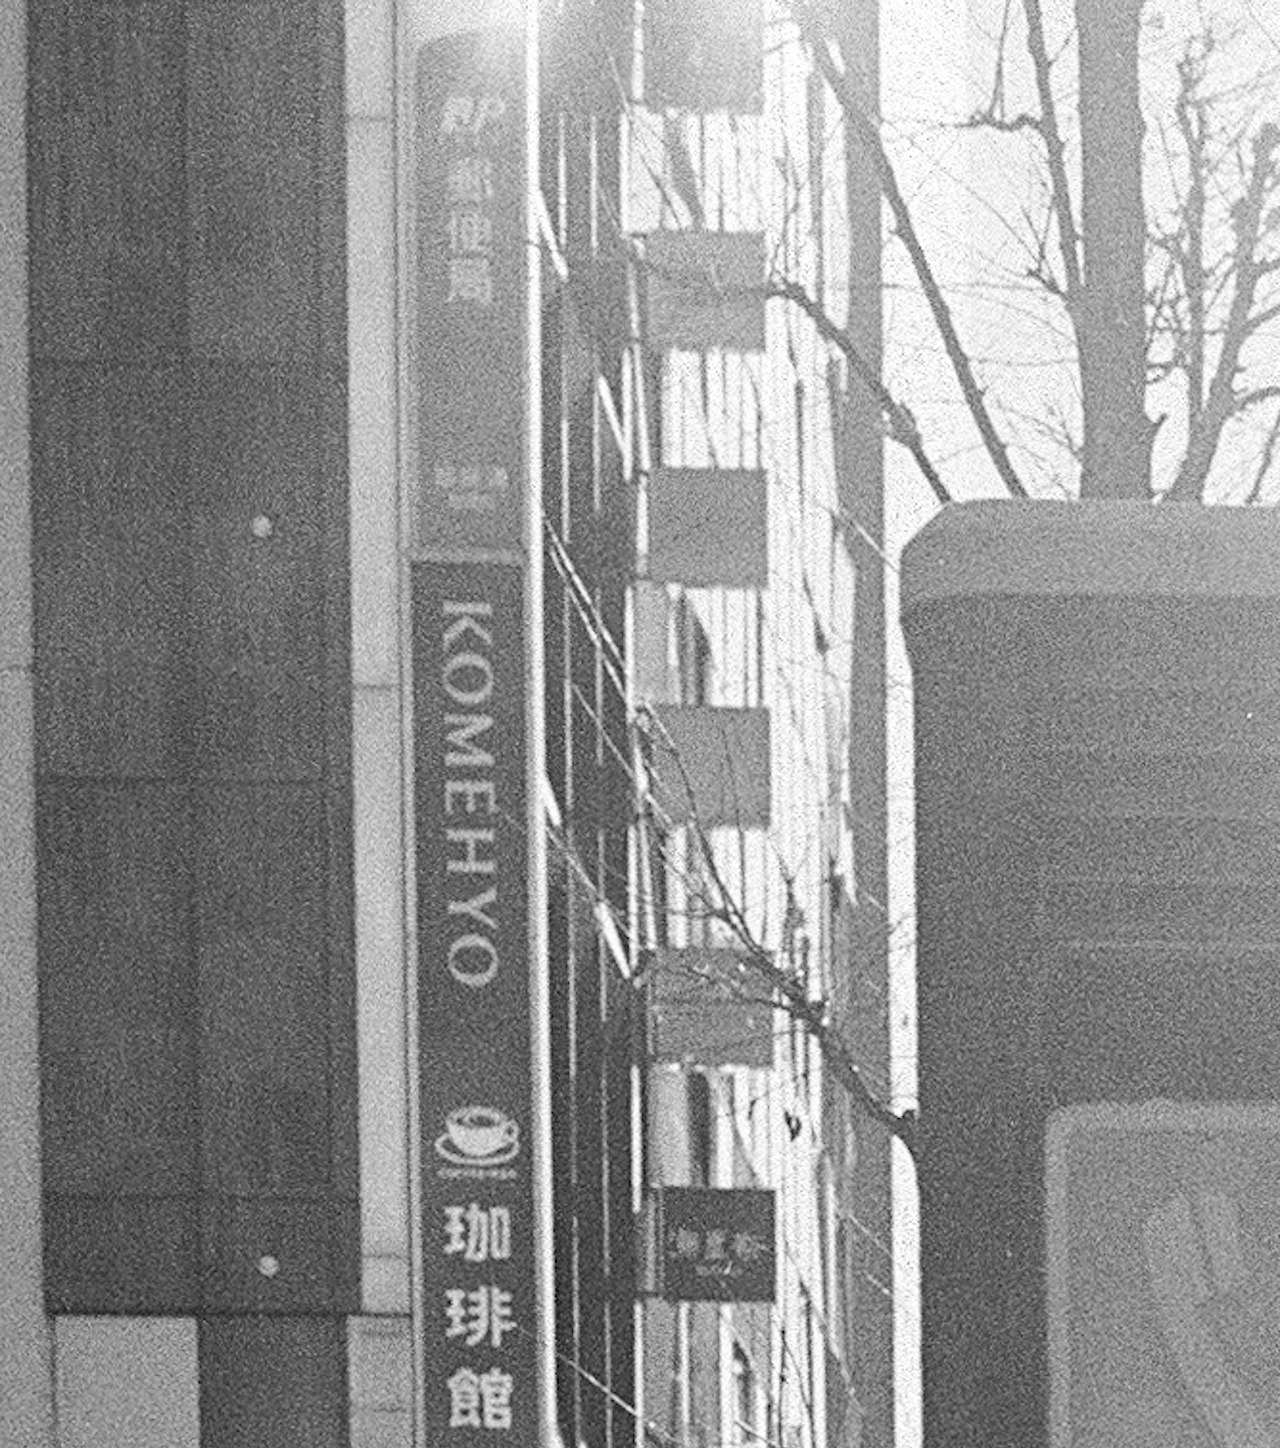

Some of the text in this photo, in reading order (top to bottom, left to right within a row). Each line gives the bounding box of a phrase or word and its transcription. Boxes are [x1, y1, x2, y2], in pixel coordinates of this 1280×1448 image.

[446, 156, 495, 305] 郵便局
[443, 602, 498, 988] KOMEHYO
[443, 1204, 517, 1430] 珈琲館
